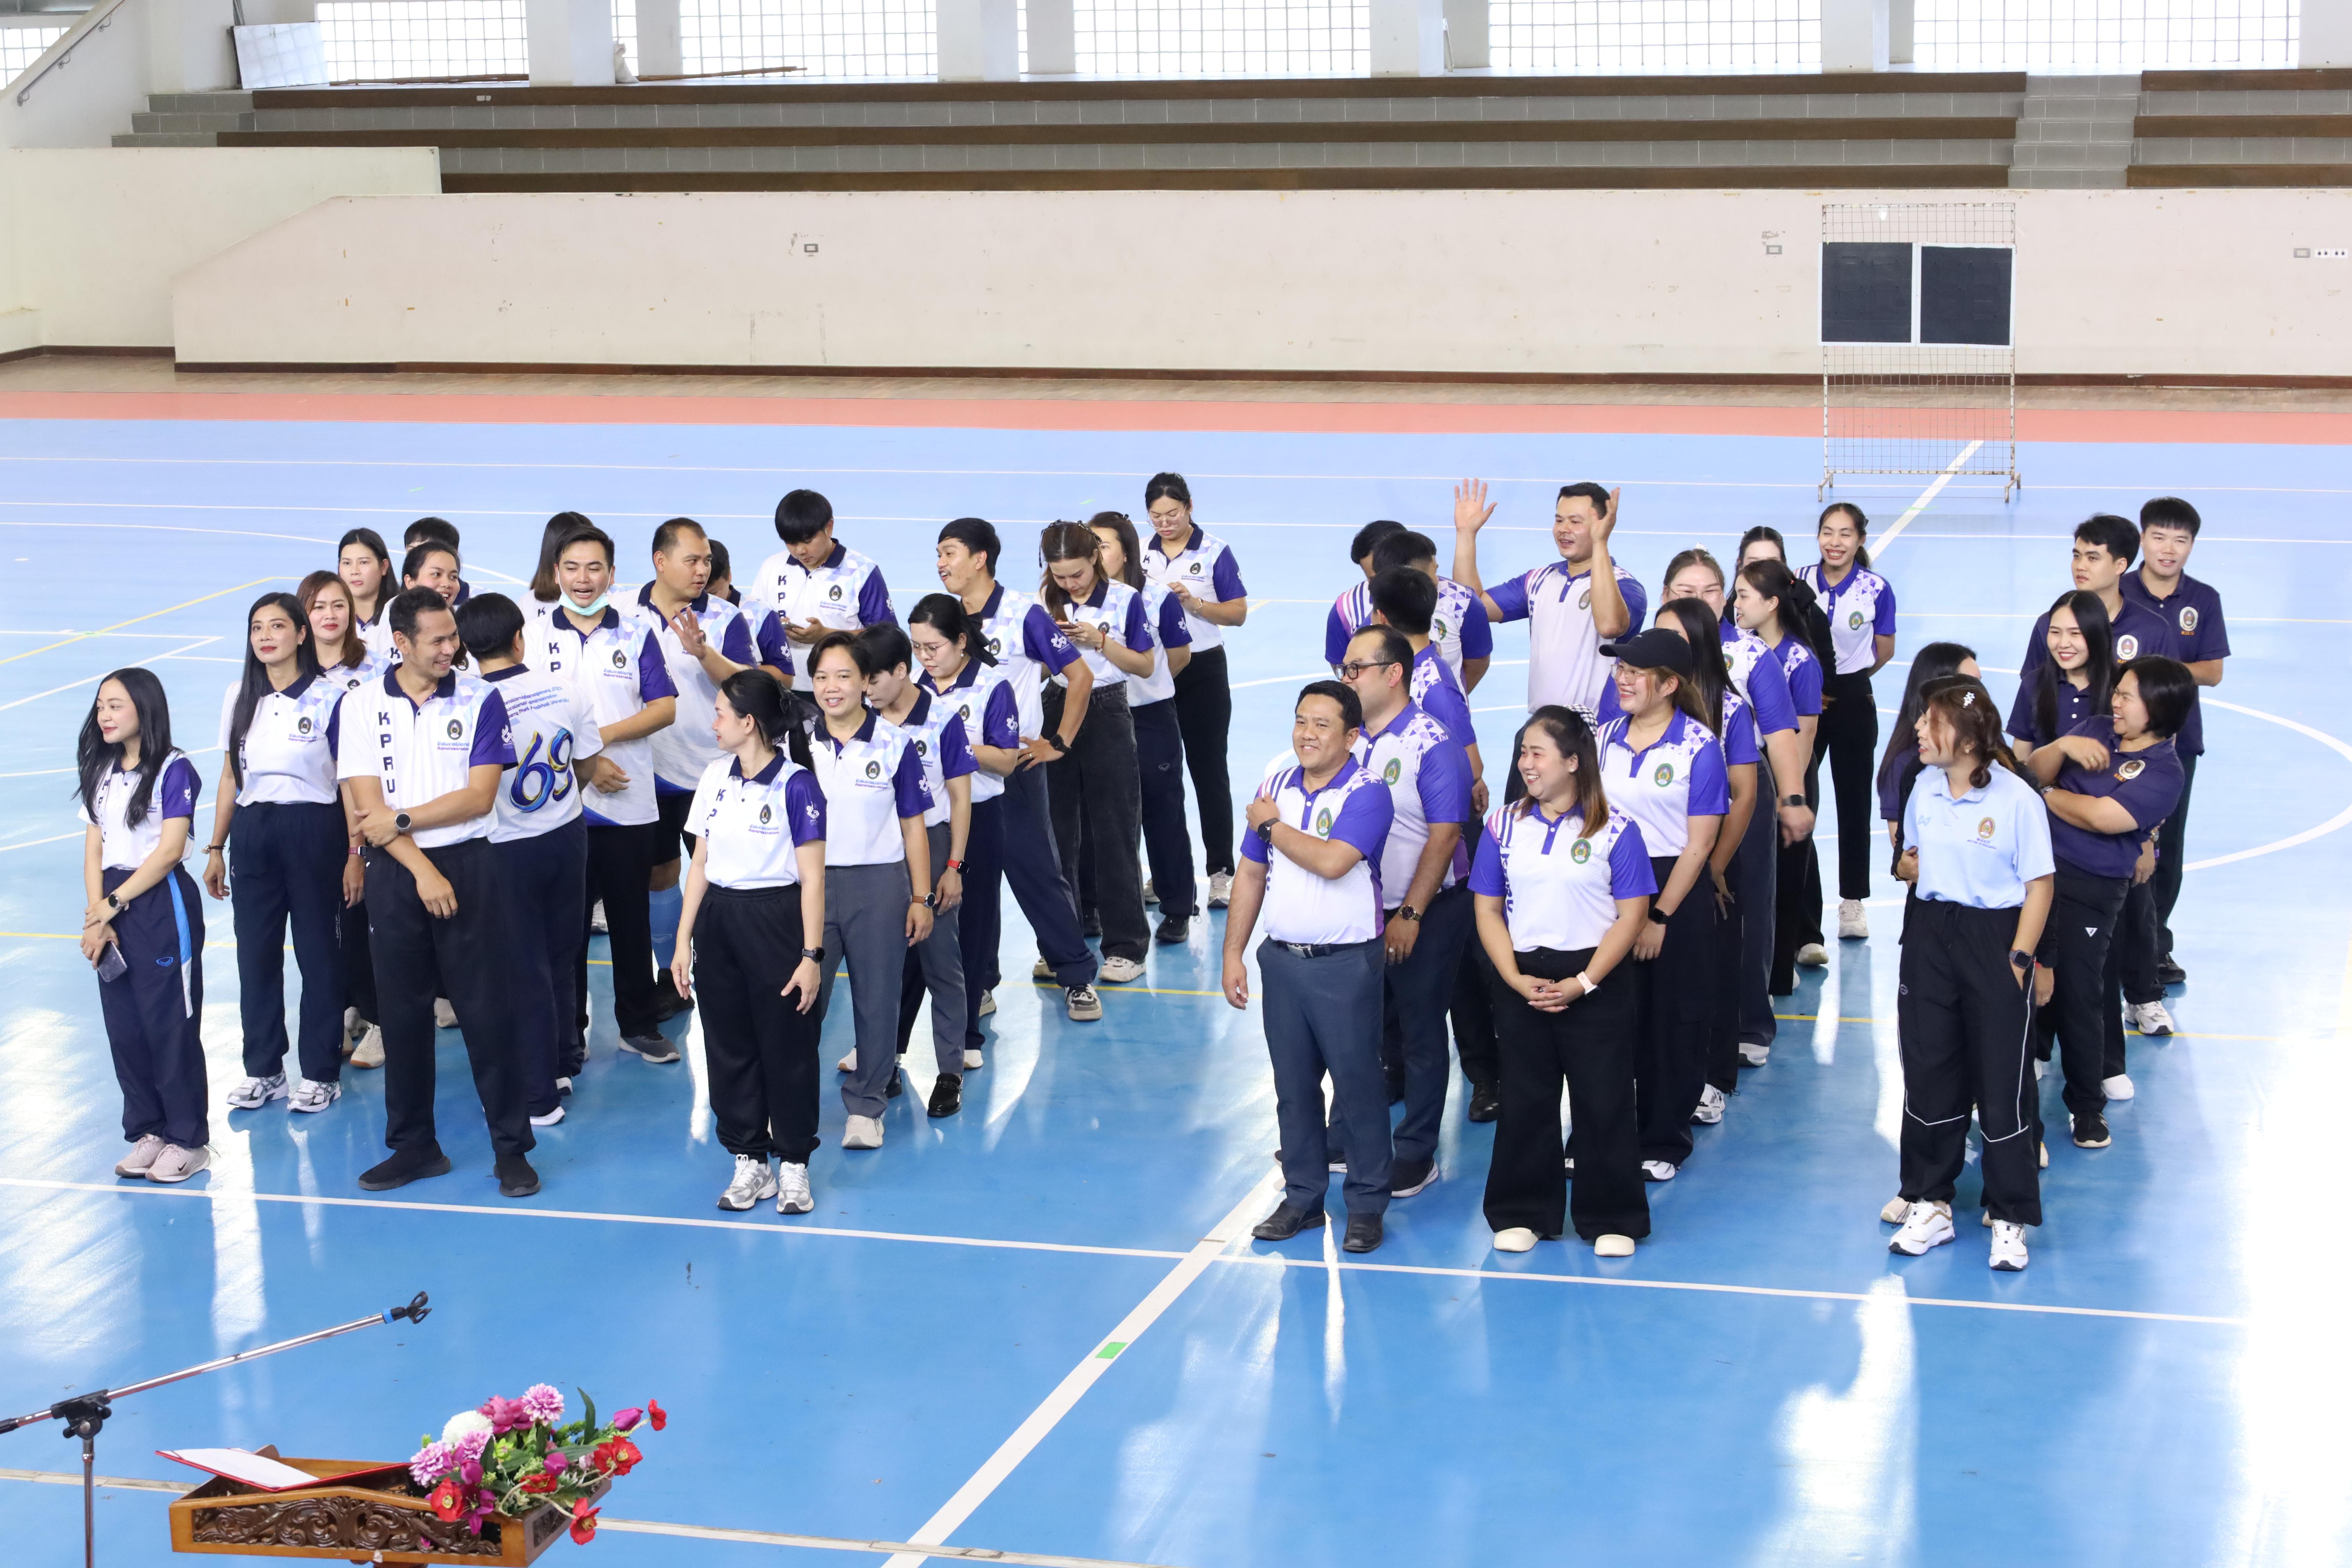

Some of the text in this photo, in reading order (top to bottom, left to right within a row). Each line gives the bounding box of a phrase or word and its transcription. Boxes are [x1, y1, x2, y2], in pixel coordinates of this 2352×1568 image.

[549, 642, 561, 672] KP
[528, 694, 558, 705] dministration
[378, 712, 396, 793] KPRU
